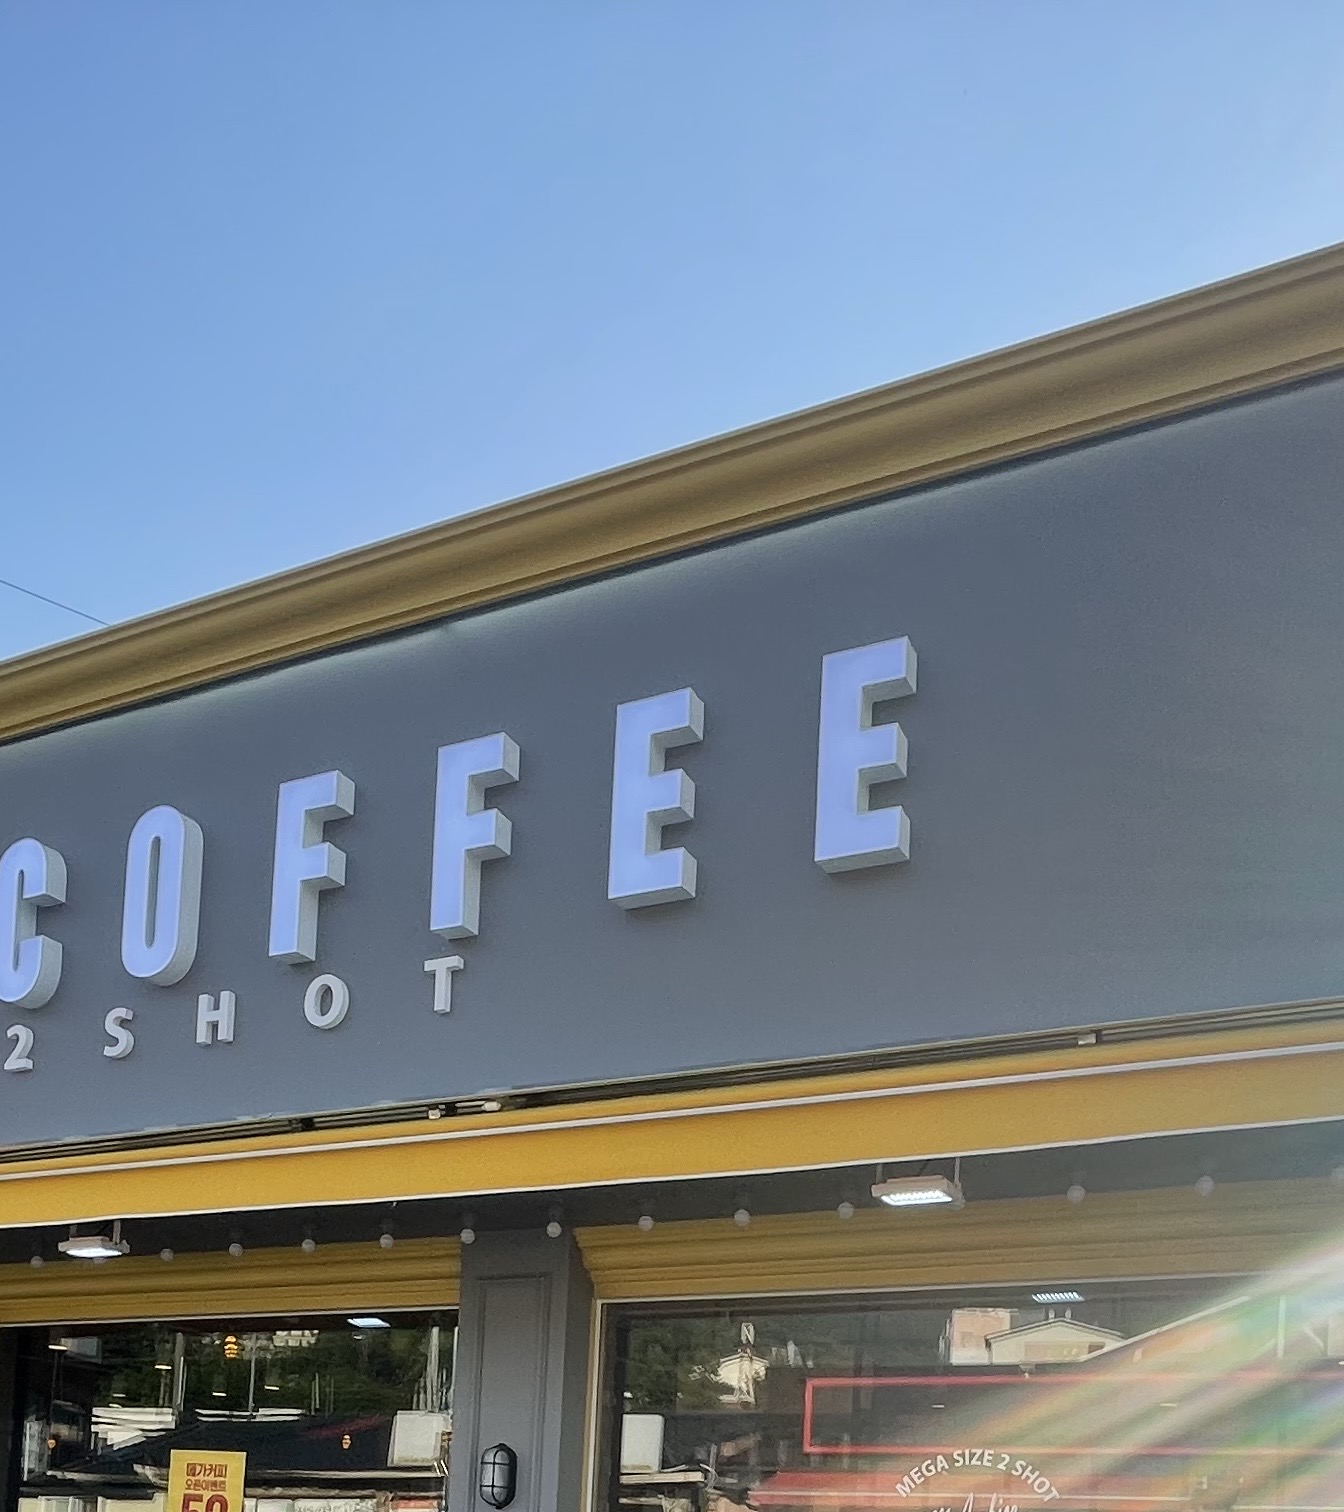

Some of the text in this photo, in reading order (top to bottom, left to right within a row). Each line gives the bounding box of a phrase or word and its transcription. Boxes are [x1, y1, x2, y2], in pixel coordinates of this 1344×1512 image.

[3, 954, 465, 1073] 2 SHOT
[186, 1462, 227, 1478] 메가커피
[895, 1449, 1060, 1502] MEGA SIZE 2 SHOT
